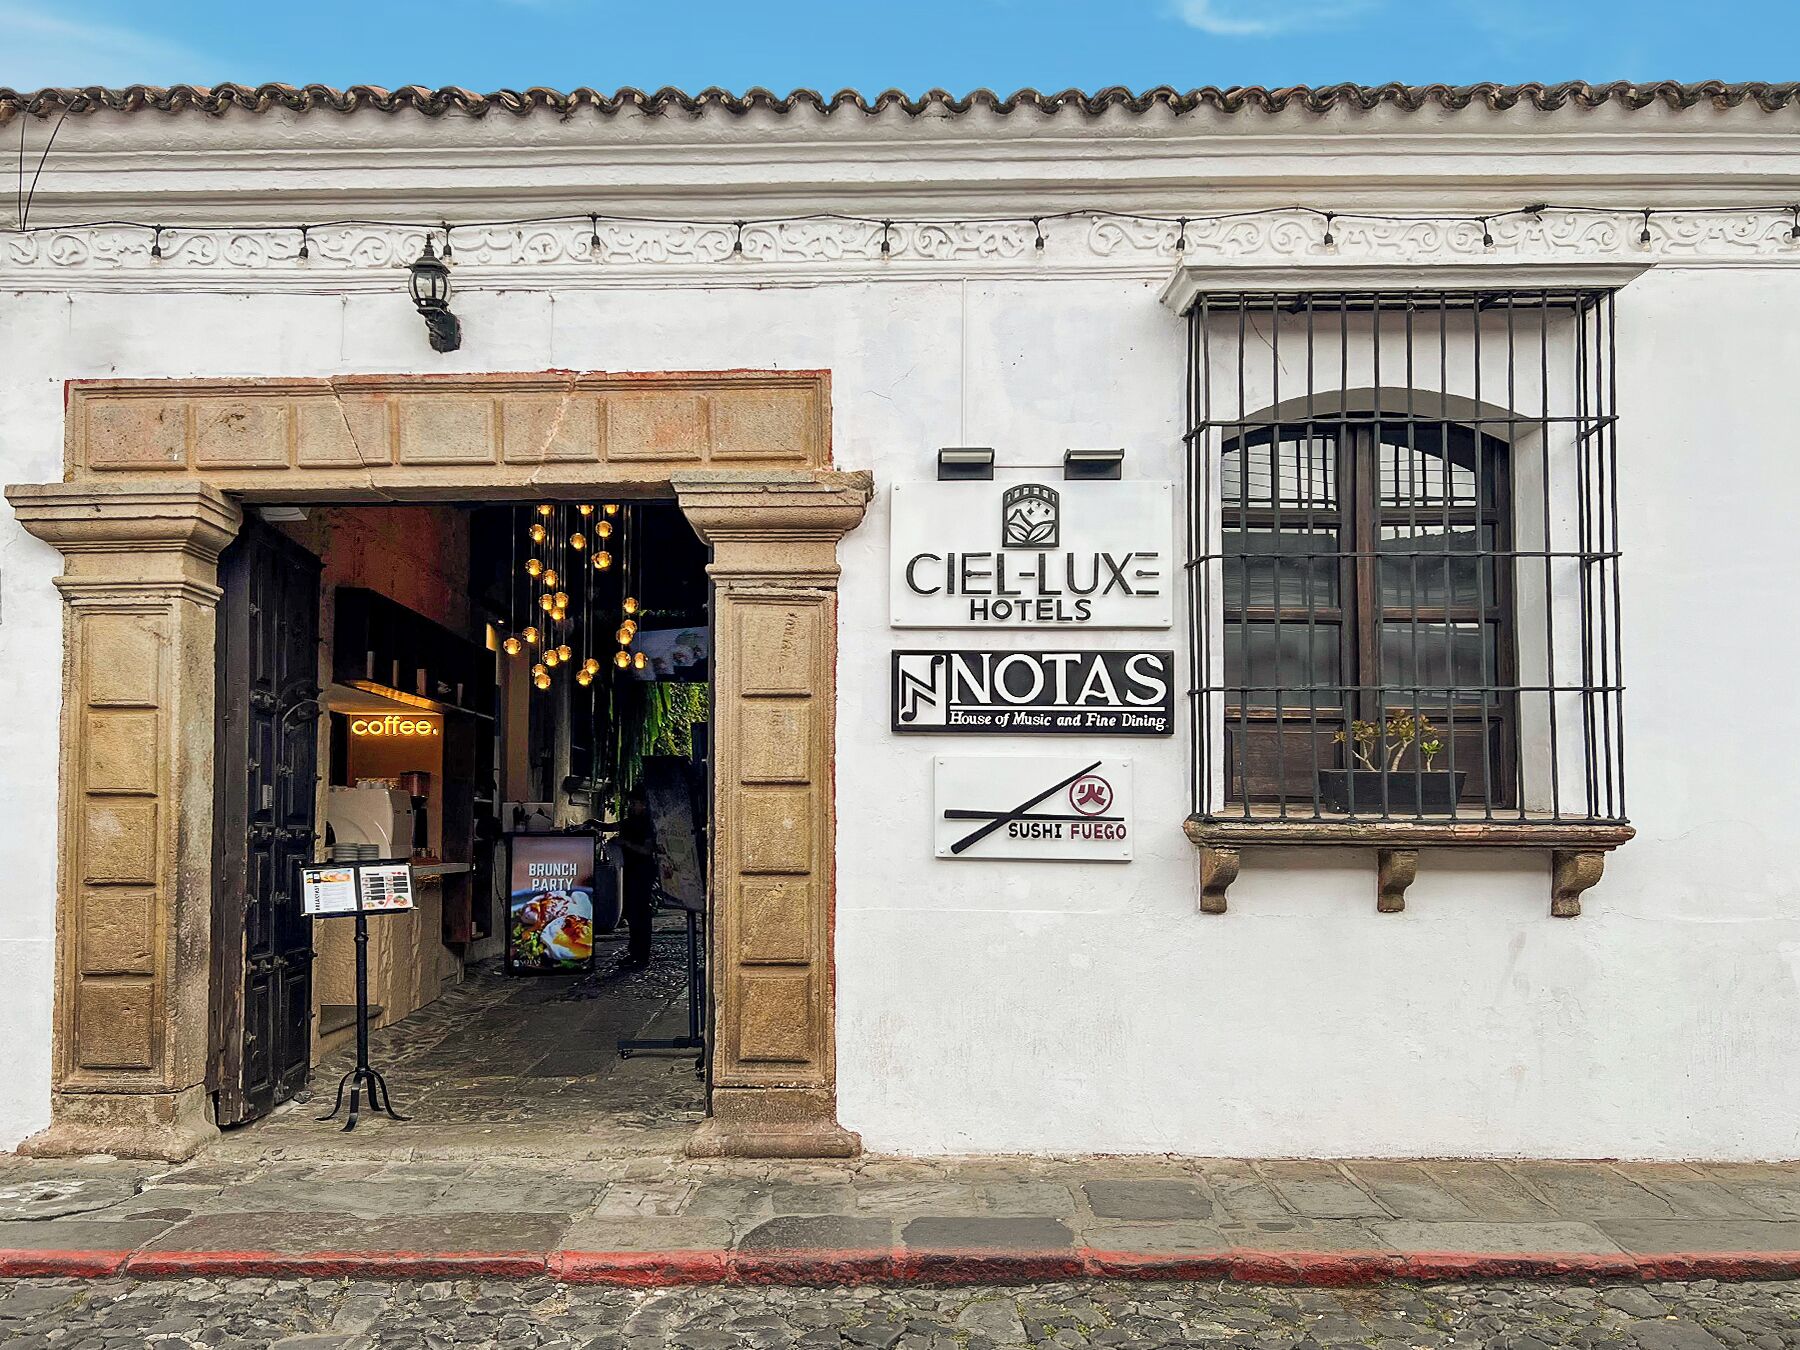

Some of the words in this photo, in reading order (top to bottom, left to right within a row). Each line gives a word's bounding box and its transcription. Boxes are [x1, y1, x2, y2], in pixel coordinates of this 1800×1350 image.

[906, 552, 1160, 596] CIEL-LUXE
[969, 598, 1092, 622] HOTELS
[950, 653, 1167, 706] NOTAS
[949, 711, 992, 726] House
[995, 712, 1011, 728] of
[1012, 712, 1052, 727] Music
[1056, 713, 1082, 727] and
[1085, 712, 1117, 728] Fine
[1121, 713, 1166, 732] Dining
[1008, 822, 1062, 839] SUSHI
[1070, 822, 1127, 840] FUEGO
[528, 863, 577, 877] BRUNCH
[531, 878, 574, 892] PARTY
